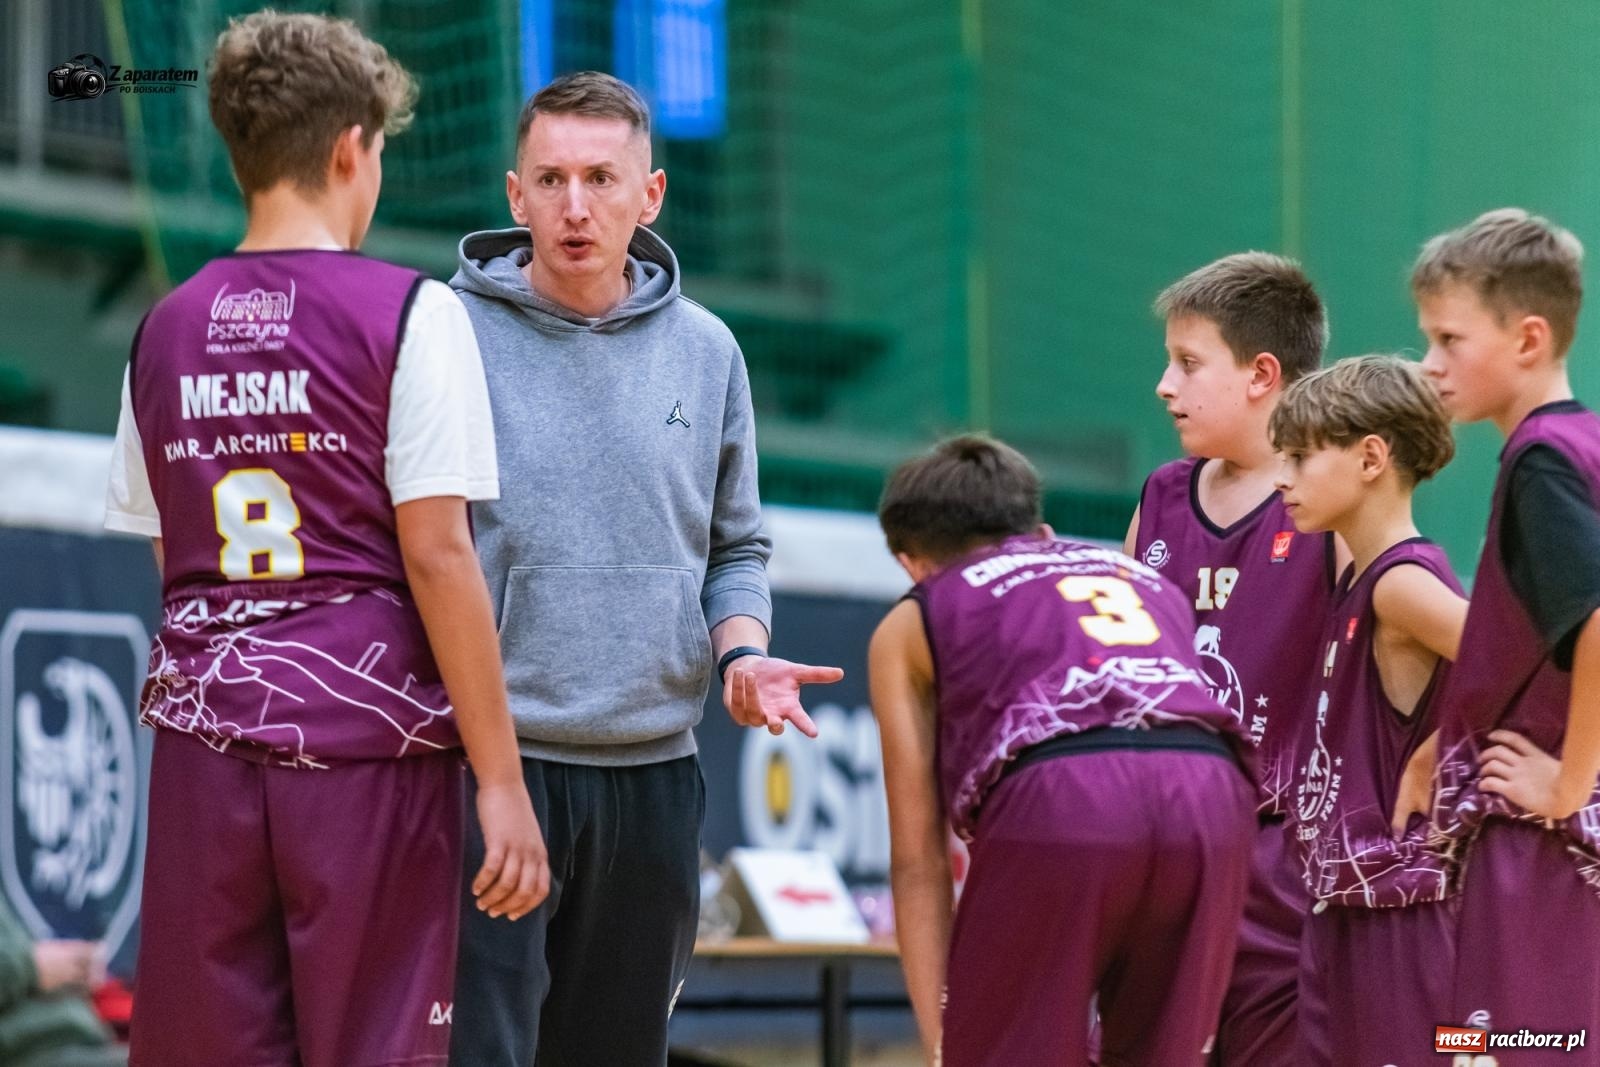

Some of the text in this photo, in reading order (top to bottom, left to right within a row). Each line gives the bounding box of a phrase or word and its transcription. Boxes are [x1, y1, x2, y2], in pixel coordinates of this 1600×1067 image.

[207, 321, 290, 342] Pszczyna
[180, 370, 312, 420] MEJSAK
[212, 468, 304, 581] 8
[1056, 575, 1162, 647] 3
